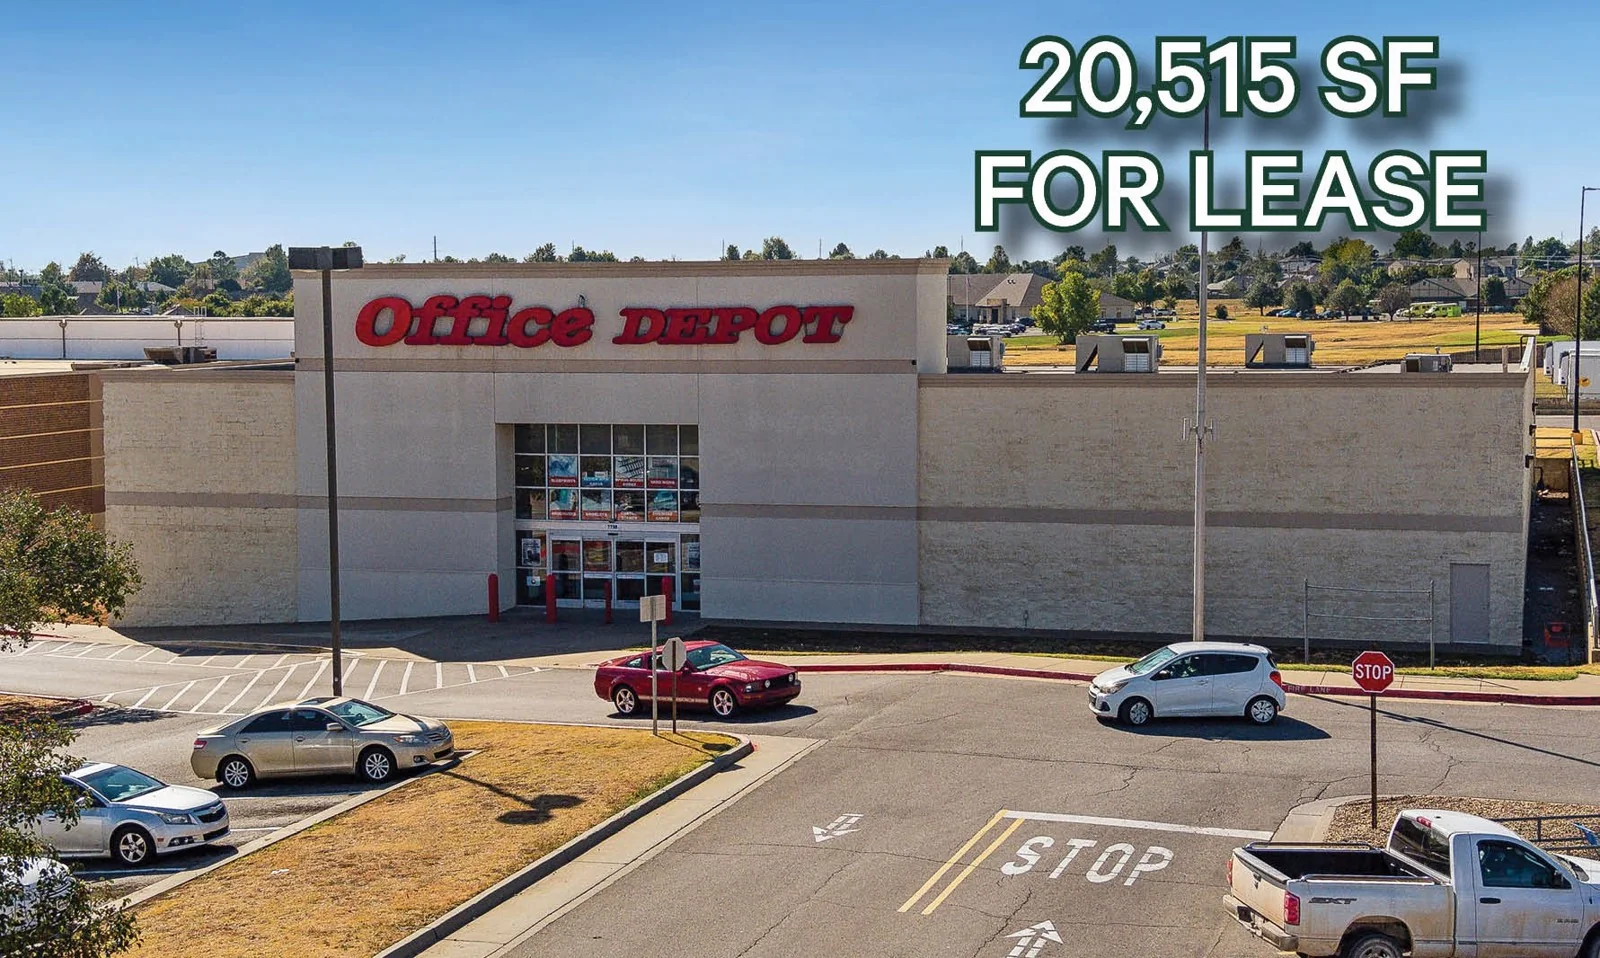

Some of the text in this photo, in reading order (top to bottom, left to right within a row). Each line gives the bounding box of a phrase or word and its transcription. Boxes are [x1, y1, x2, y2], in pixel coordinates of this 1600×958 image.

[355, 294, 854, 348] Office DEPOT
[1355, 664, 1391, 680] STOP
[1000, 835, 1174, 886] STOP
